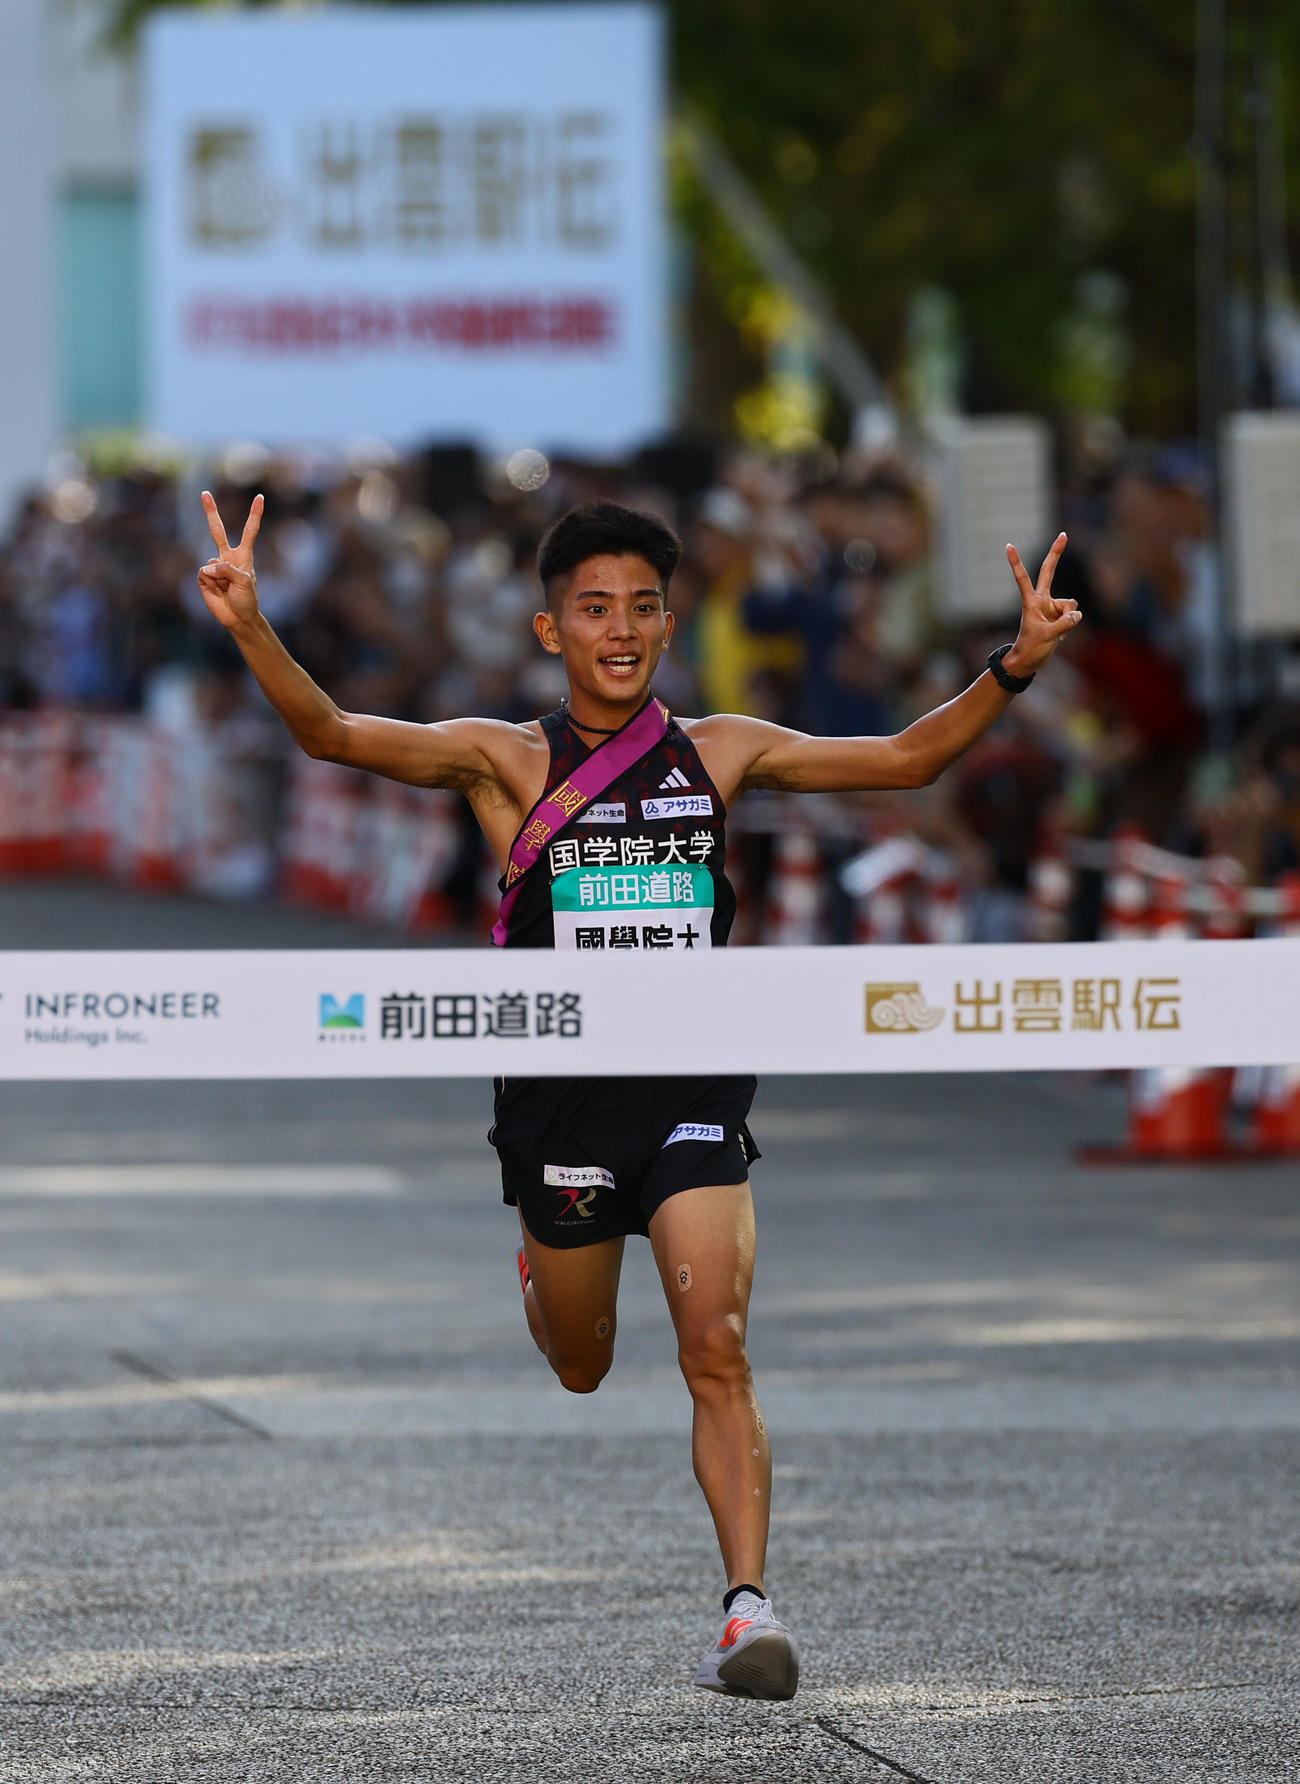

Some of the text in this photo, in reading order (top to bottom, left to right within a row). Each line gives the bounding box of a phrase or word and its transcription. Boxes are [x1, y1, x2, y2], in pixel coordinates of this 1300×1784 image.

[663, 798, 710, 813] アサガミ
[549, 830, 715, 876] 国学院大学
[578, 871, 695, 906] 前田道路
[25, 992, 220, 1018] INFRONEER
[380, 992, 582, 1040] 前田道路
[953, 977, 1182, 1033] 出雲駅伝
[25, 1027, 148, 1047] Holdings Inc.
[672, 1126, 721, 1139] アサガミ
